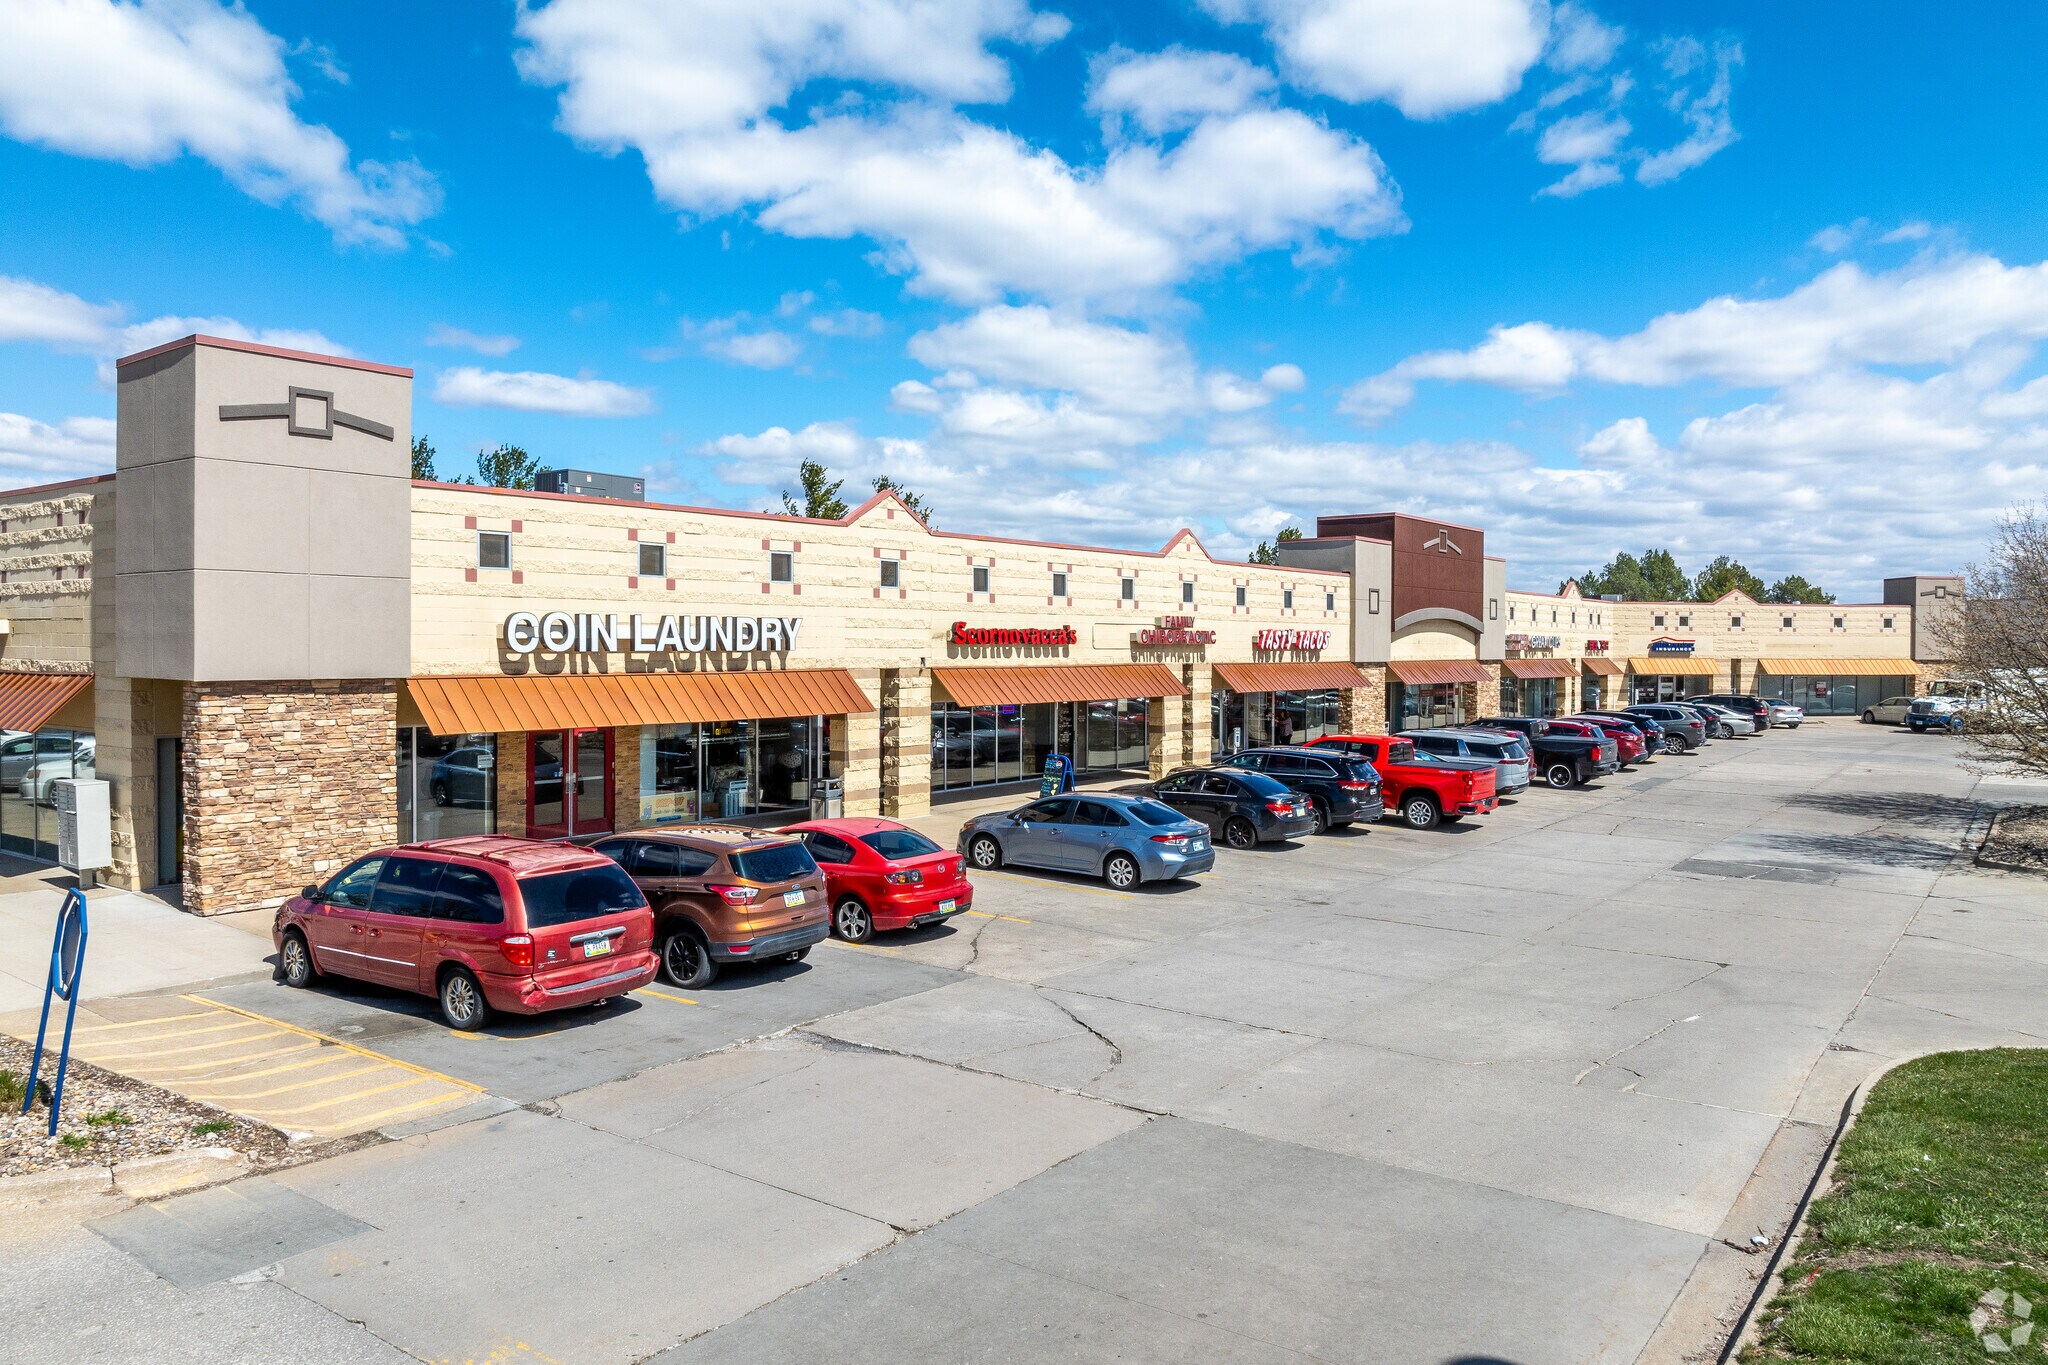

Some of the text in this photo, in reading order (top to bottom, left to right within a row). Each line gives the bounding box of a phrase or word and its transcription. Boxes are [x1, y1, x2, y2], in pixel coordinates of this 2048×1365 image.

[504, 611, 804, 653] COIN LAUNDRY
[1165, 615, 1196, 628] FAMILY
[953, 621, 1077, 645] Scornovacca's
[1140, 628, 1217, 645] CHIROPRACTIC
[1258, 629, 1331, 650] TASTY TACOS
